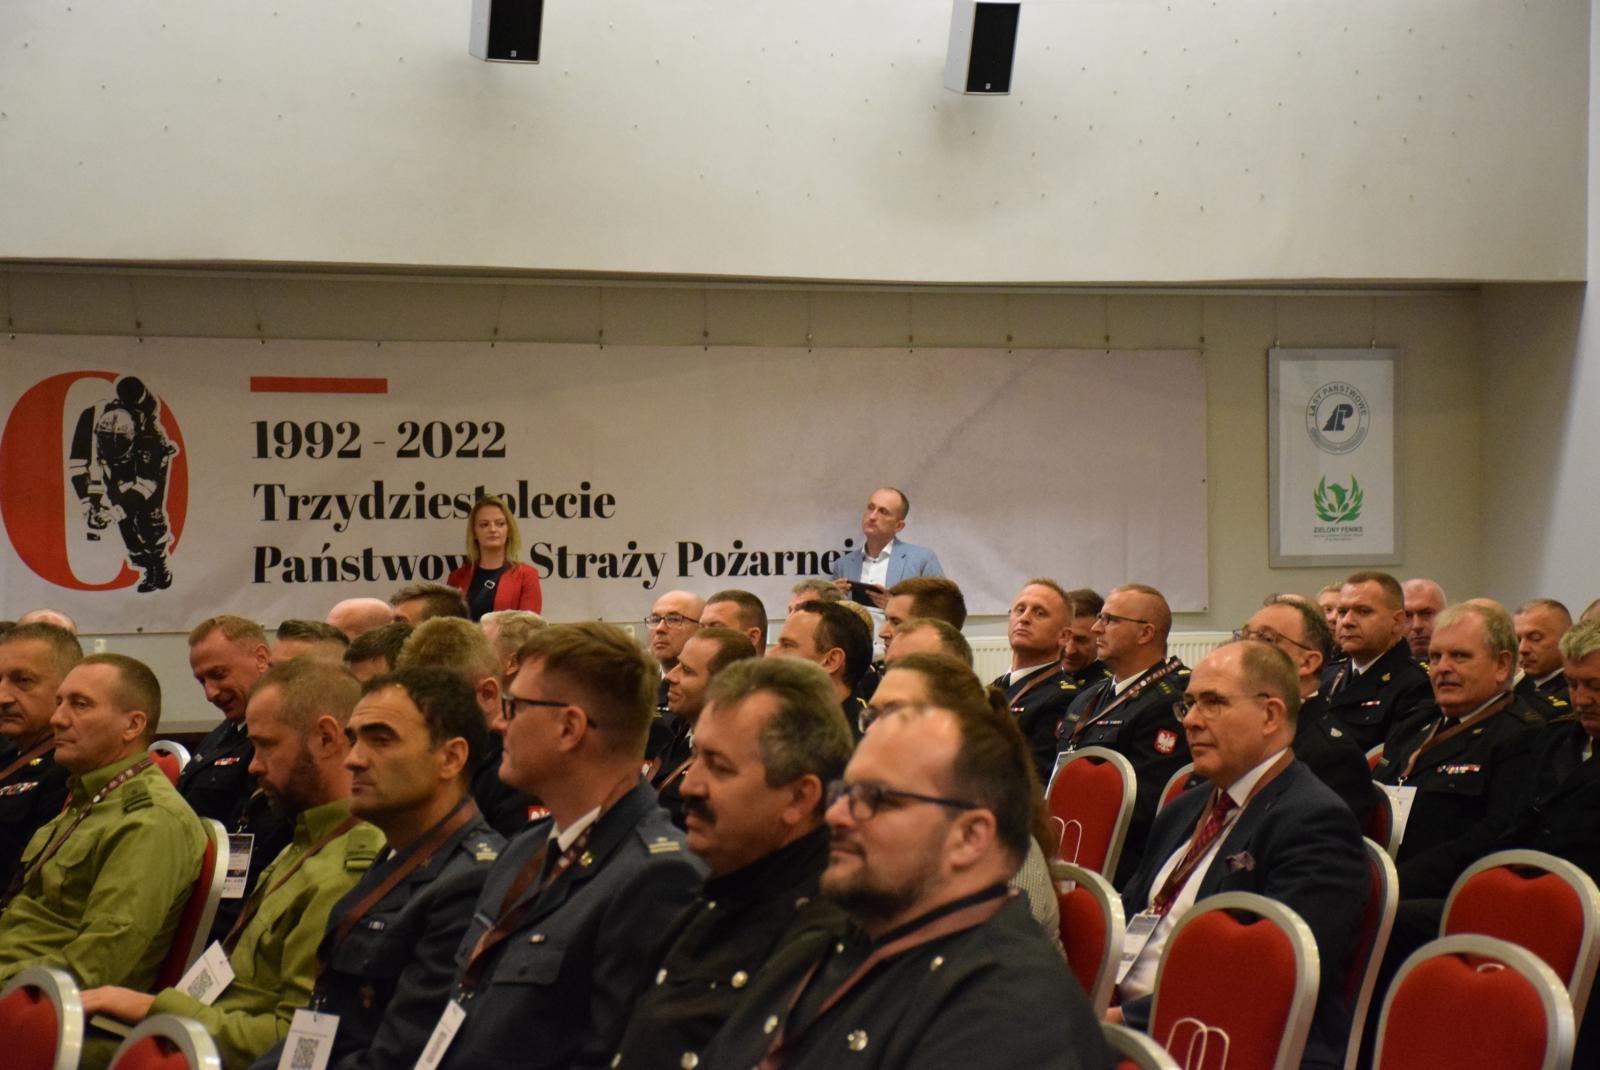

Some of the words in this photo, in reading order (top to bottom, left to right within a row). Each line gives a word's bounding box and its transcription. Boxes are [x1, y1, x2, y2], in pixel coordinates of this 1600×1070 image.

[251, 420, 362, 459] 1992
[396, 420, 507, 459] 2022
[252, 542, 468, 584] Państwo
[529, 540, 666, 590] Straży
